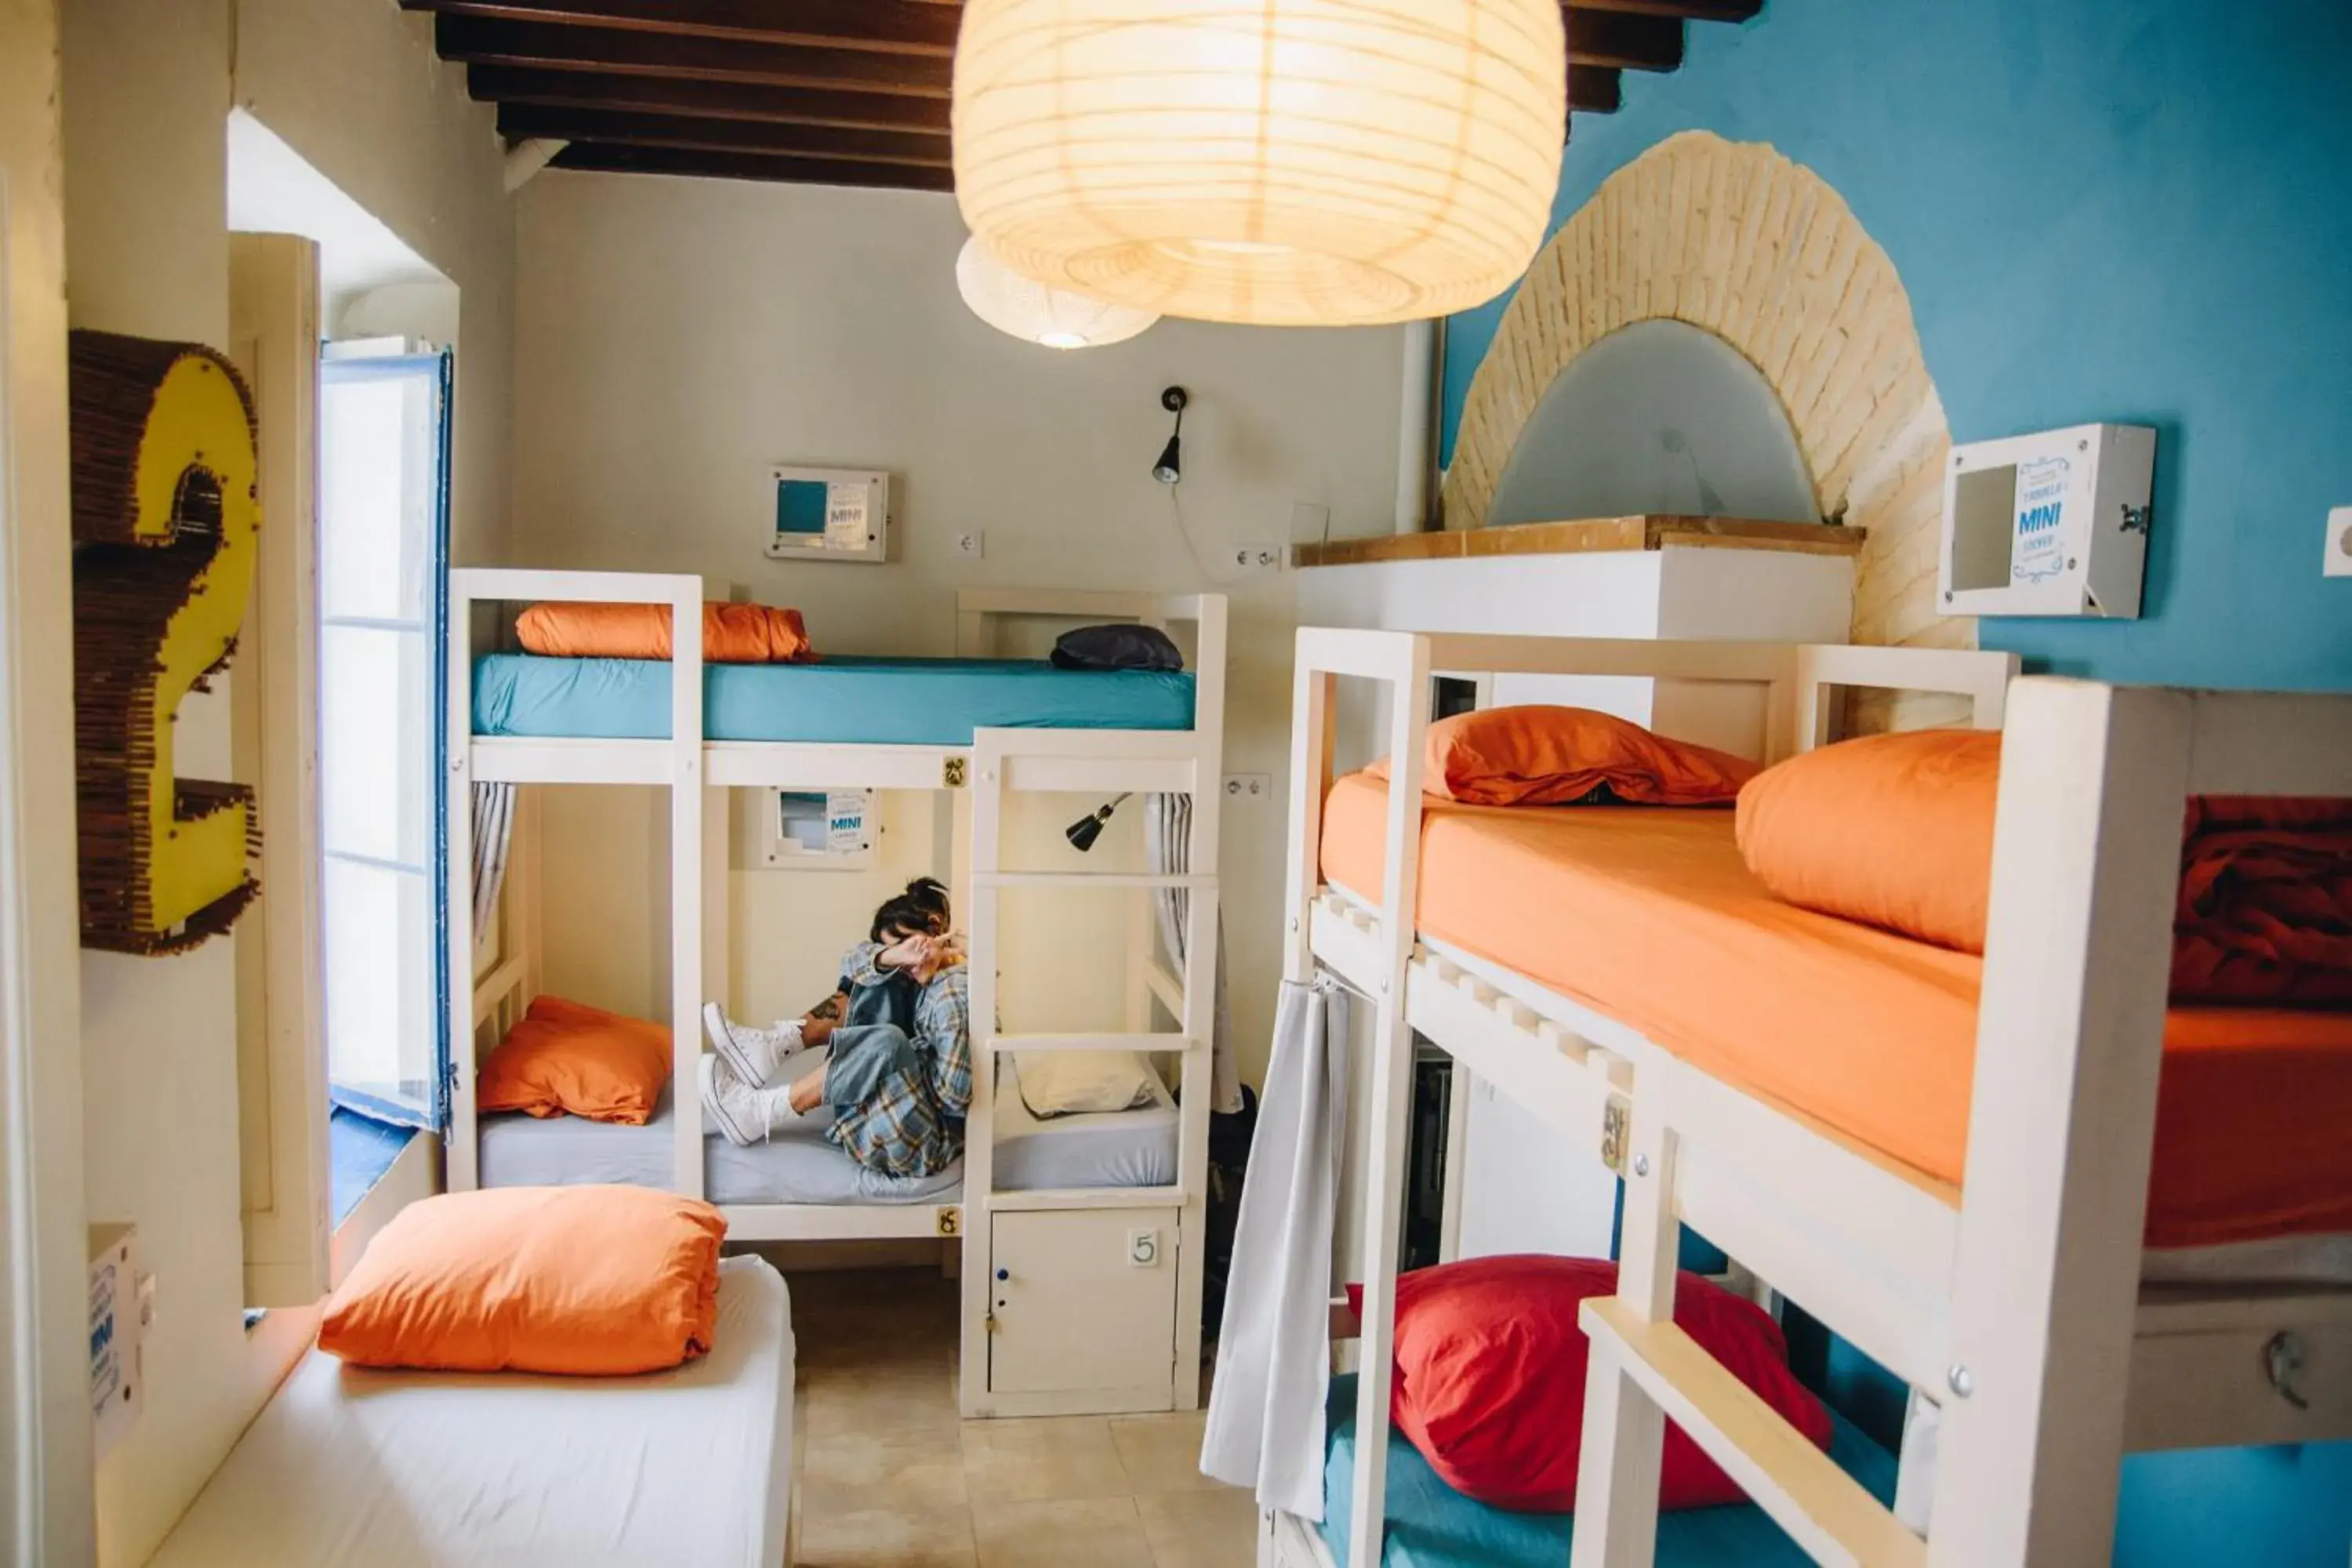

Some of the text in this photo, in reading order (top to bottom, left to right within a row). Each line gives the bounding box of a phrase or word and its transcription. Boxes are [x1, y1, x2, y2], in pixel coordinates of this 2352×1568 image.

[830, 509, 862, 523] MINI
[2019, 501, 2061, 535] MINI
[129, 350, 262, 938] 2
[831, 816, 862, 831] MINI
[1133, 1235, 1155, 1263] 5
